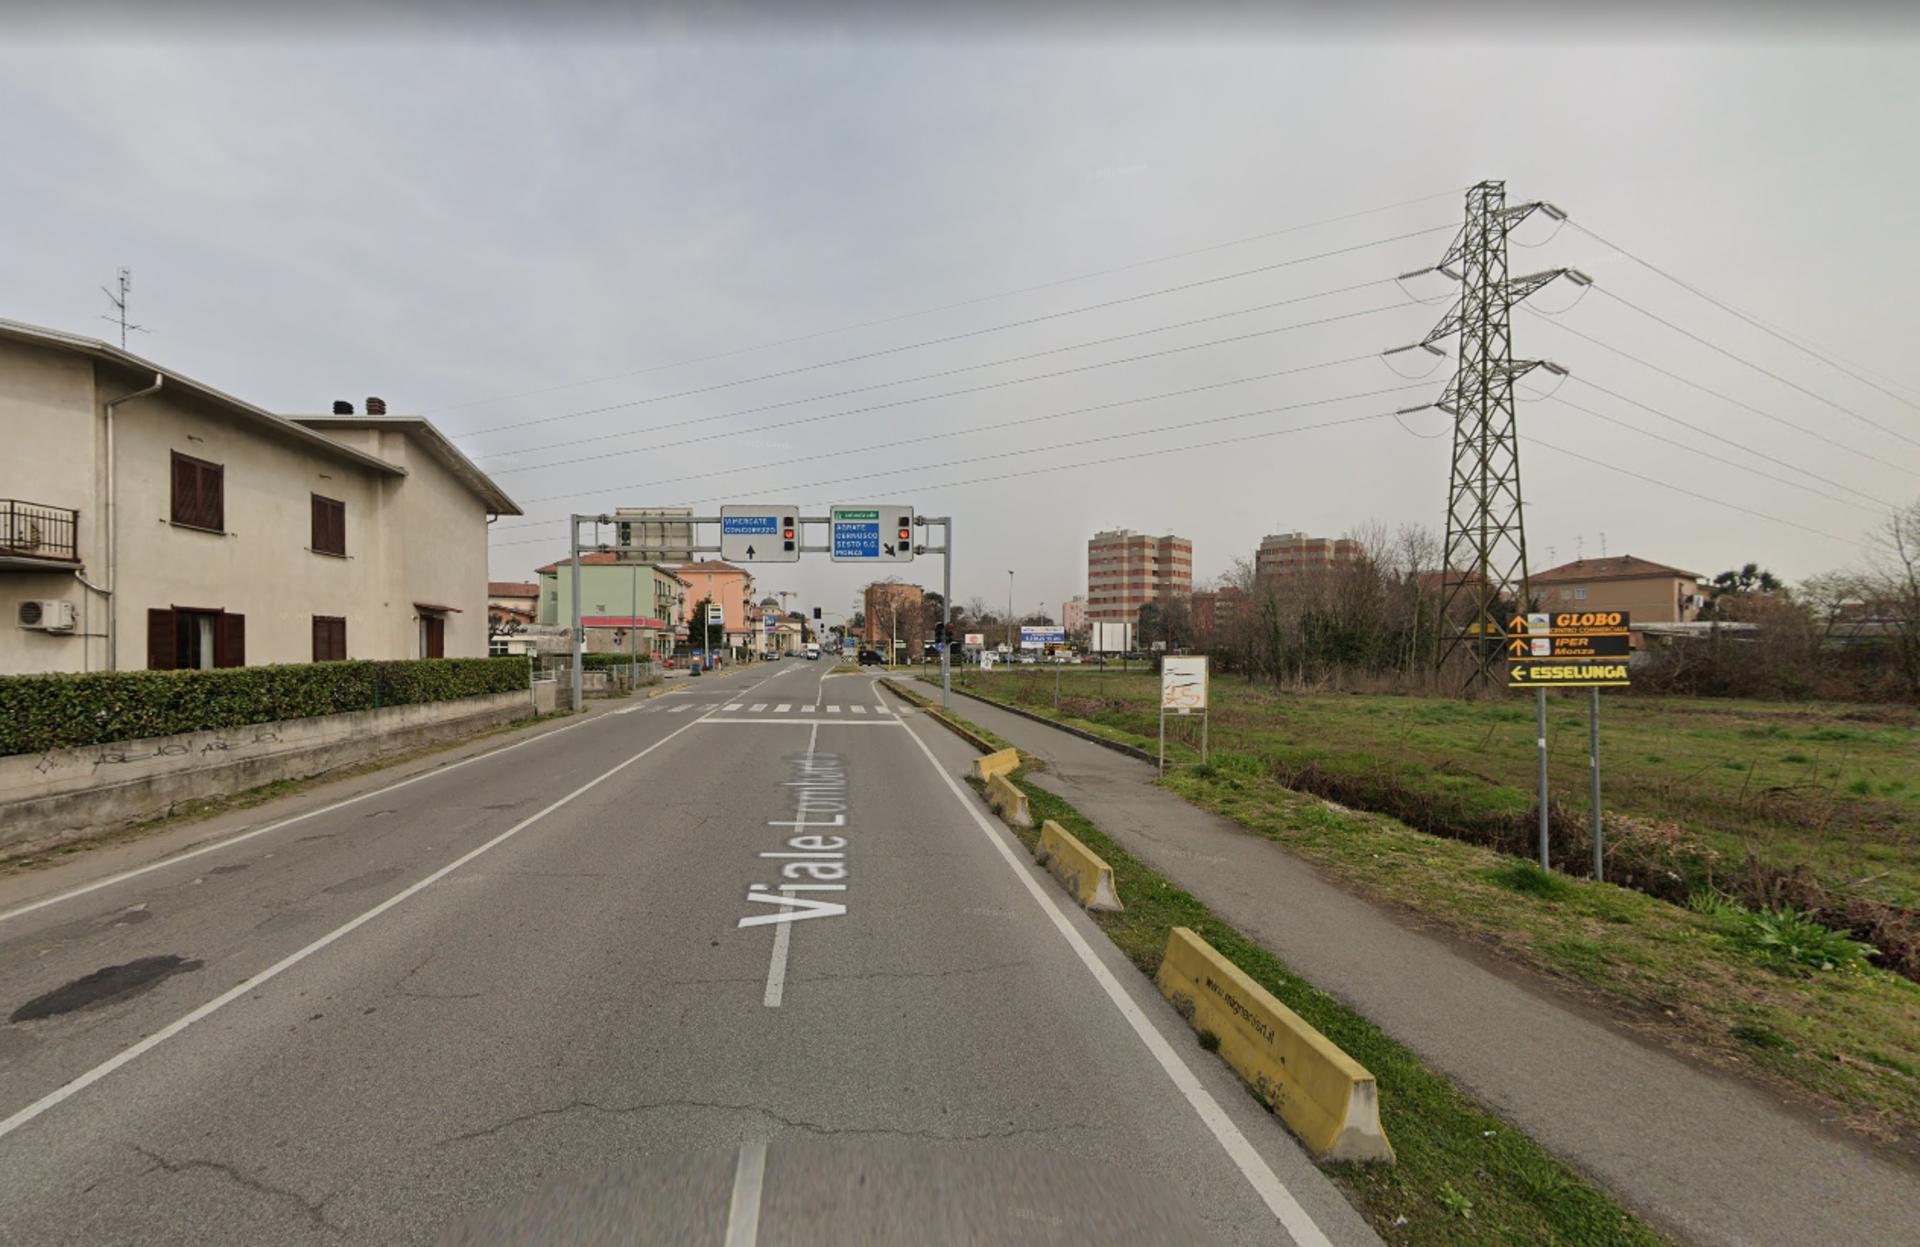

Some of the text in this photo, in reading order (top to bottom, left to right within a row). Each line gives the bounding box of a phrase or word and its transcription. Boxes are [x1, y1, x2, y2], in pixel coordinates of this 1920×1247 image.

[1556, 612, 1622, 627] GLOBO
[1554, 637, 1590, 647] IPER
[1554, 648, 1596, 656] Monza
[1529, 665, 1628, 680] ESSELUNGA
